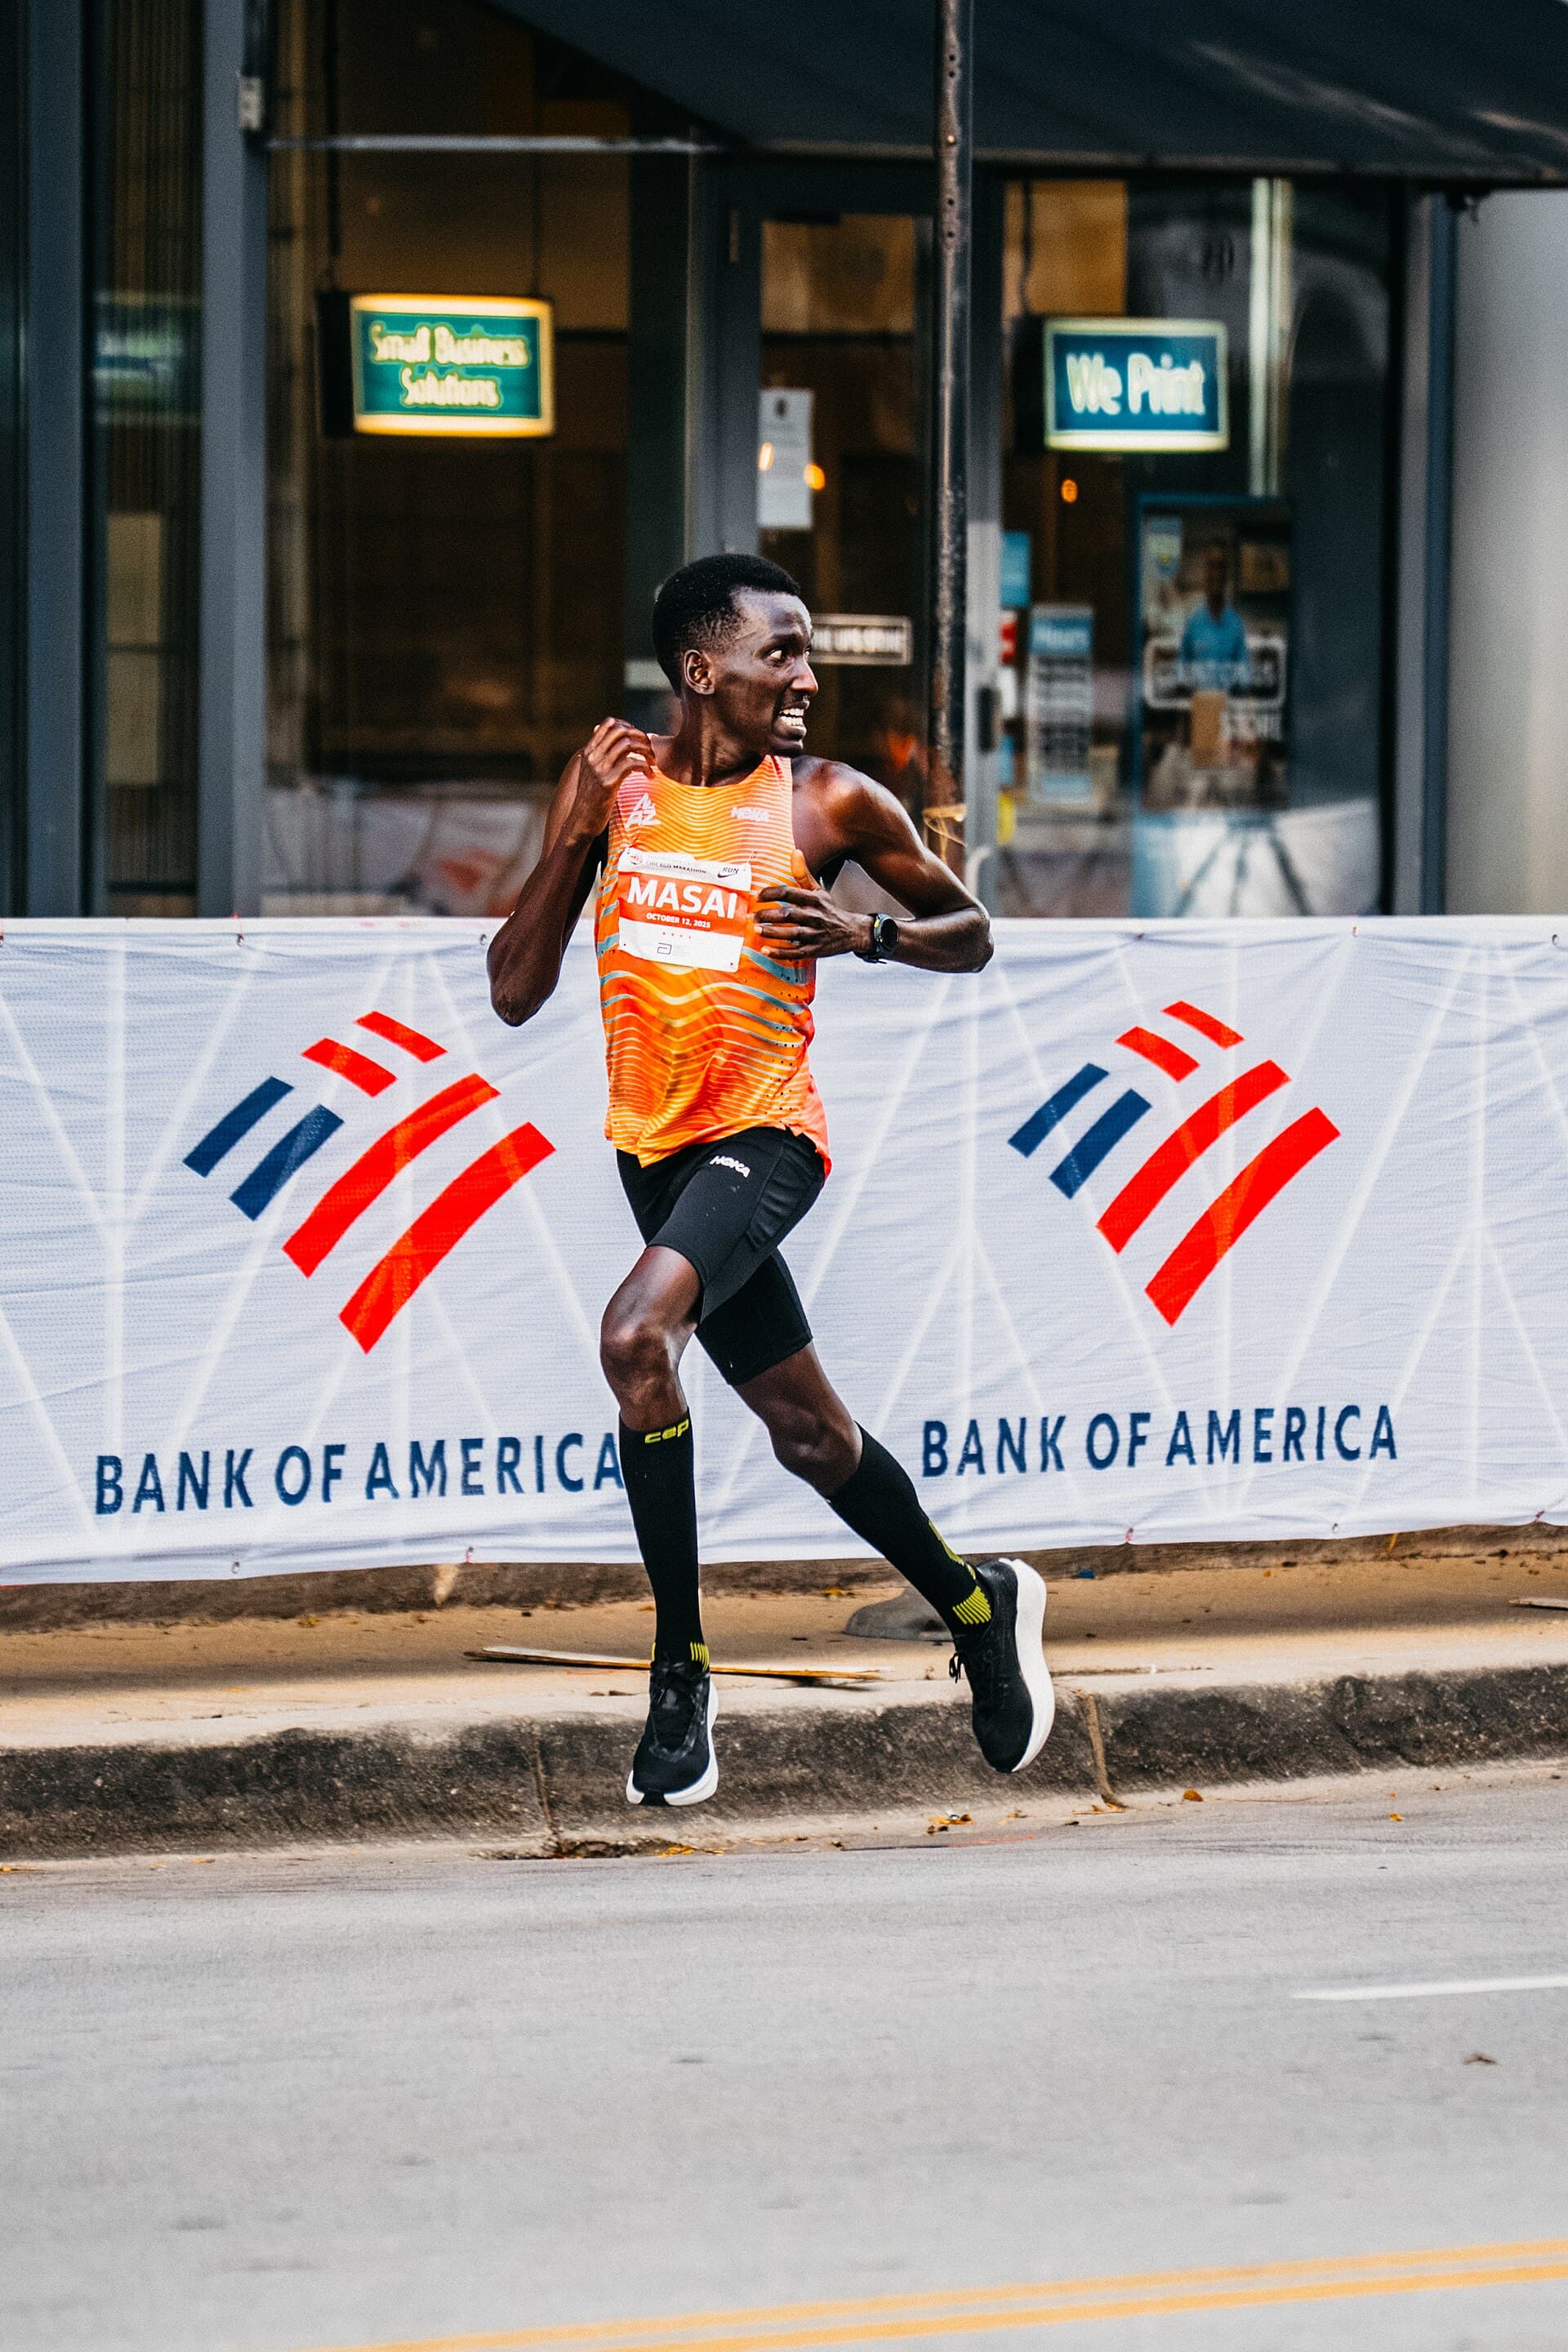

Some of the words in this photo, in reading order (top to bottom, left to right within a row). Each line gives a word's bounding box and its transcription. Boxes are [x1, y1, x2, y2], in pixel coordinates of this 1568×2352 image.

[371, 324, 430, 363] Small
[434, 325, 528, 366] Business
[401, 367, 501, 408] Solutions
[1067, 354, 1121, 415] We
[1128, 354, 1205, 414] Print
[627, 876, 737, 920] MASAI
[646, 912, 679, 924] OCTOBER
[682, 917, 692, 926] 12,
[693, 920, 711, 929] 2025
[644, 1419, 689, 1444] cep
[922, 1416, 1067, 1477] BANK
[1086, 1412, 1151, 1471] OF
[1165, 1405, 1397, 1466] AMERICA
[96, 1448, 255, 1515] BANK
[275, 1444, 345, 1506] OF
[365, 1432, 623, 1500] AMERICA
